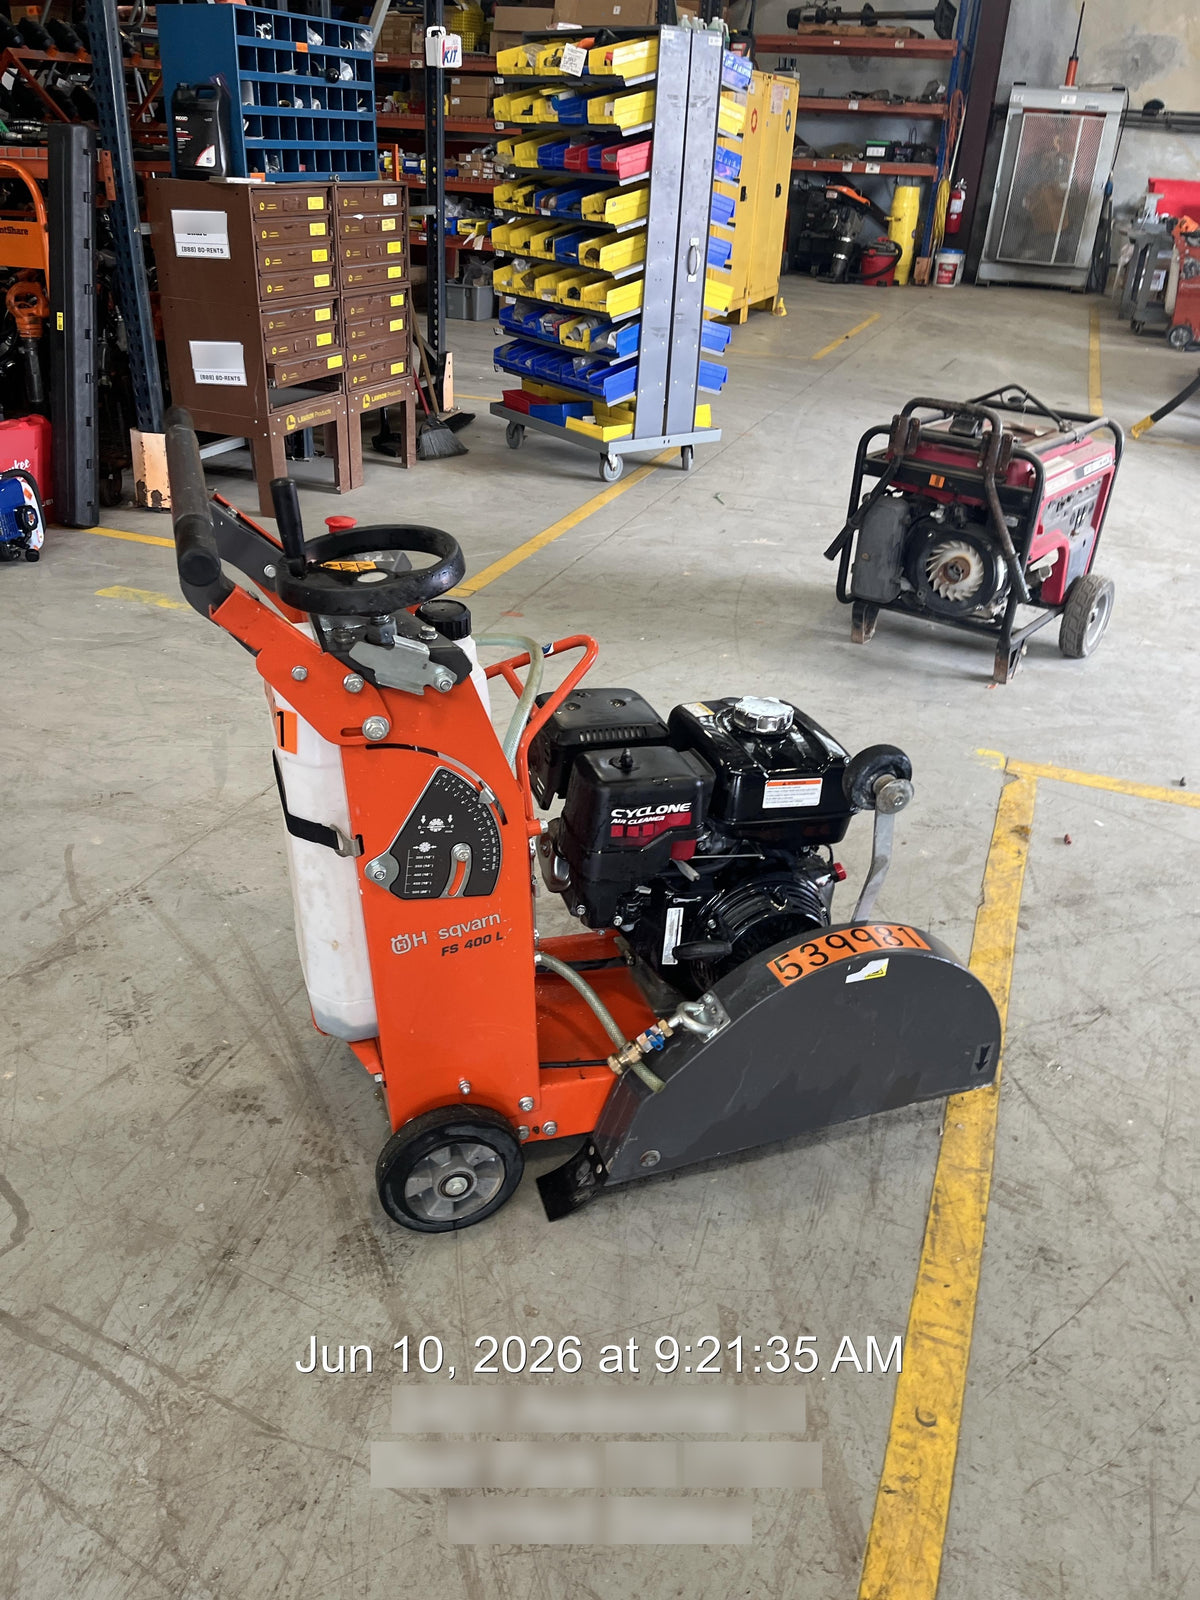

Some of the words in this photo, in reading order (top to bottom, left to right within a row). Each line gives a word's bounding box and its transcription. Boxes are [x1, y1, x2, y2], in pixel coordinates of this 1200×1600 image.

[442, 49, 458, 63] KIT
[610, 802, 692, 818] CYCLONE
[627, 815, 666, 825] CLEANER
[441, 943, 459, 957] FS
[464, 934, 492, 949] 400
[495, 931, 504, 941] L
[774, 926, 921, 981] 539981
